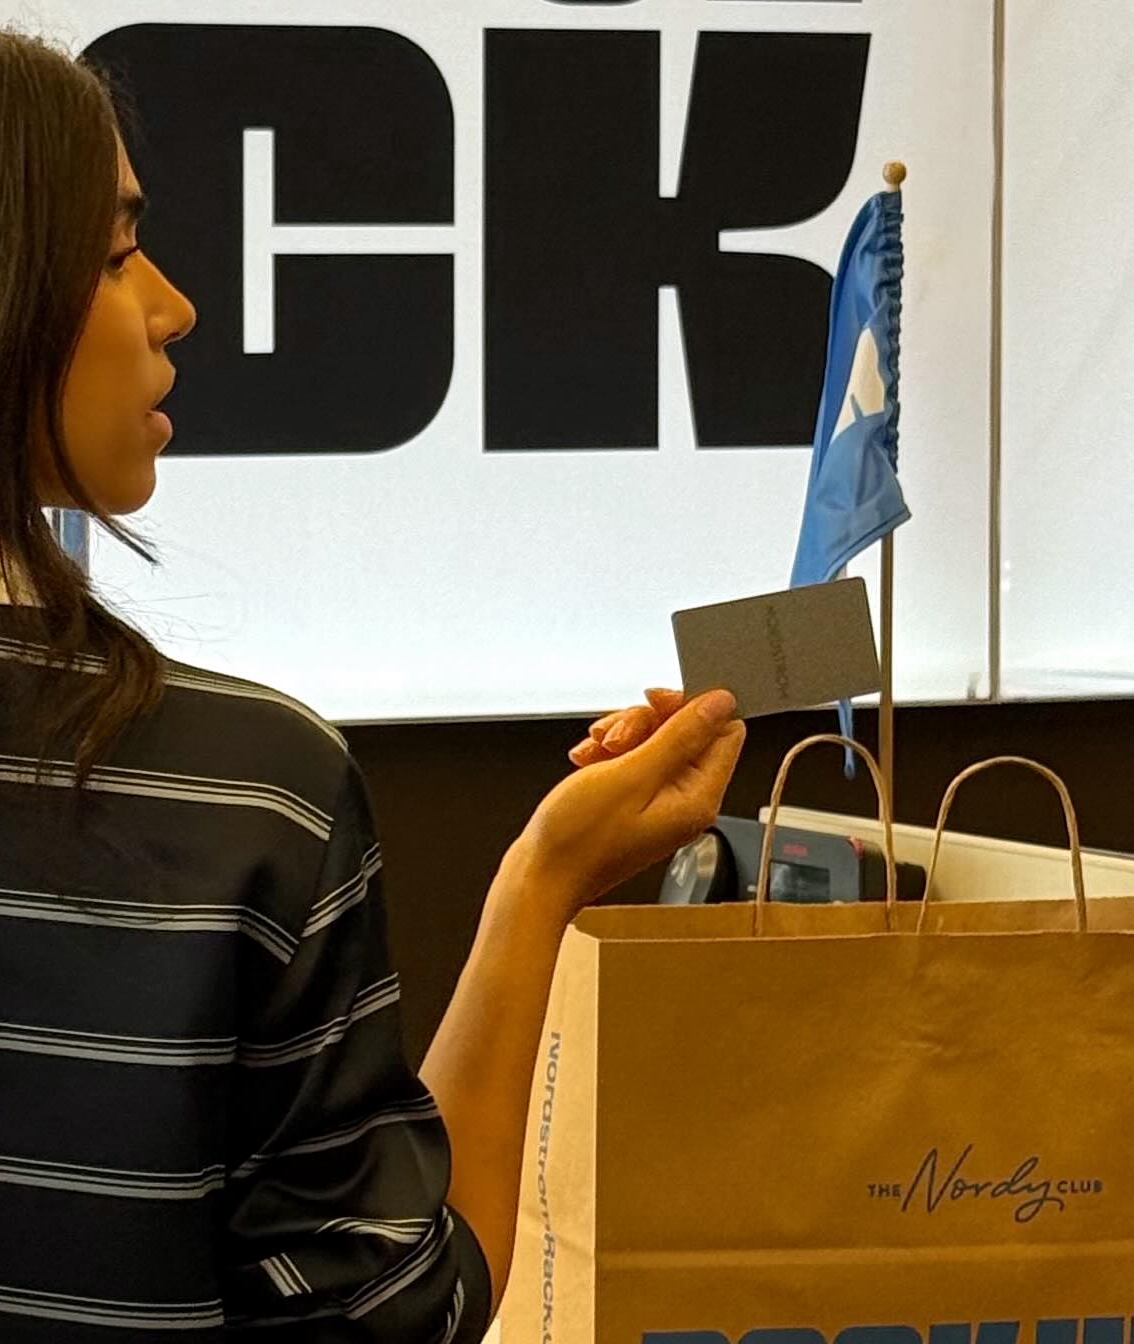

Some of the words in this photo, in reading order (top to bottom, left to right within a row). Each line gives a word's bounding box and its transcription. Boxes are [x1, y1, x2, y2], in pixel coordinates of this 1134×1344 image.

[867, 1183, 902, 1198] THE
[900, 1143, 1065, 1224] Nordy
[1057, 1179, 1104, 1194] CLUB
